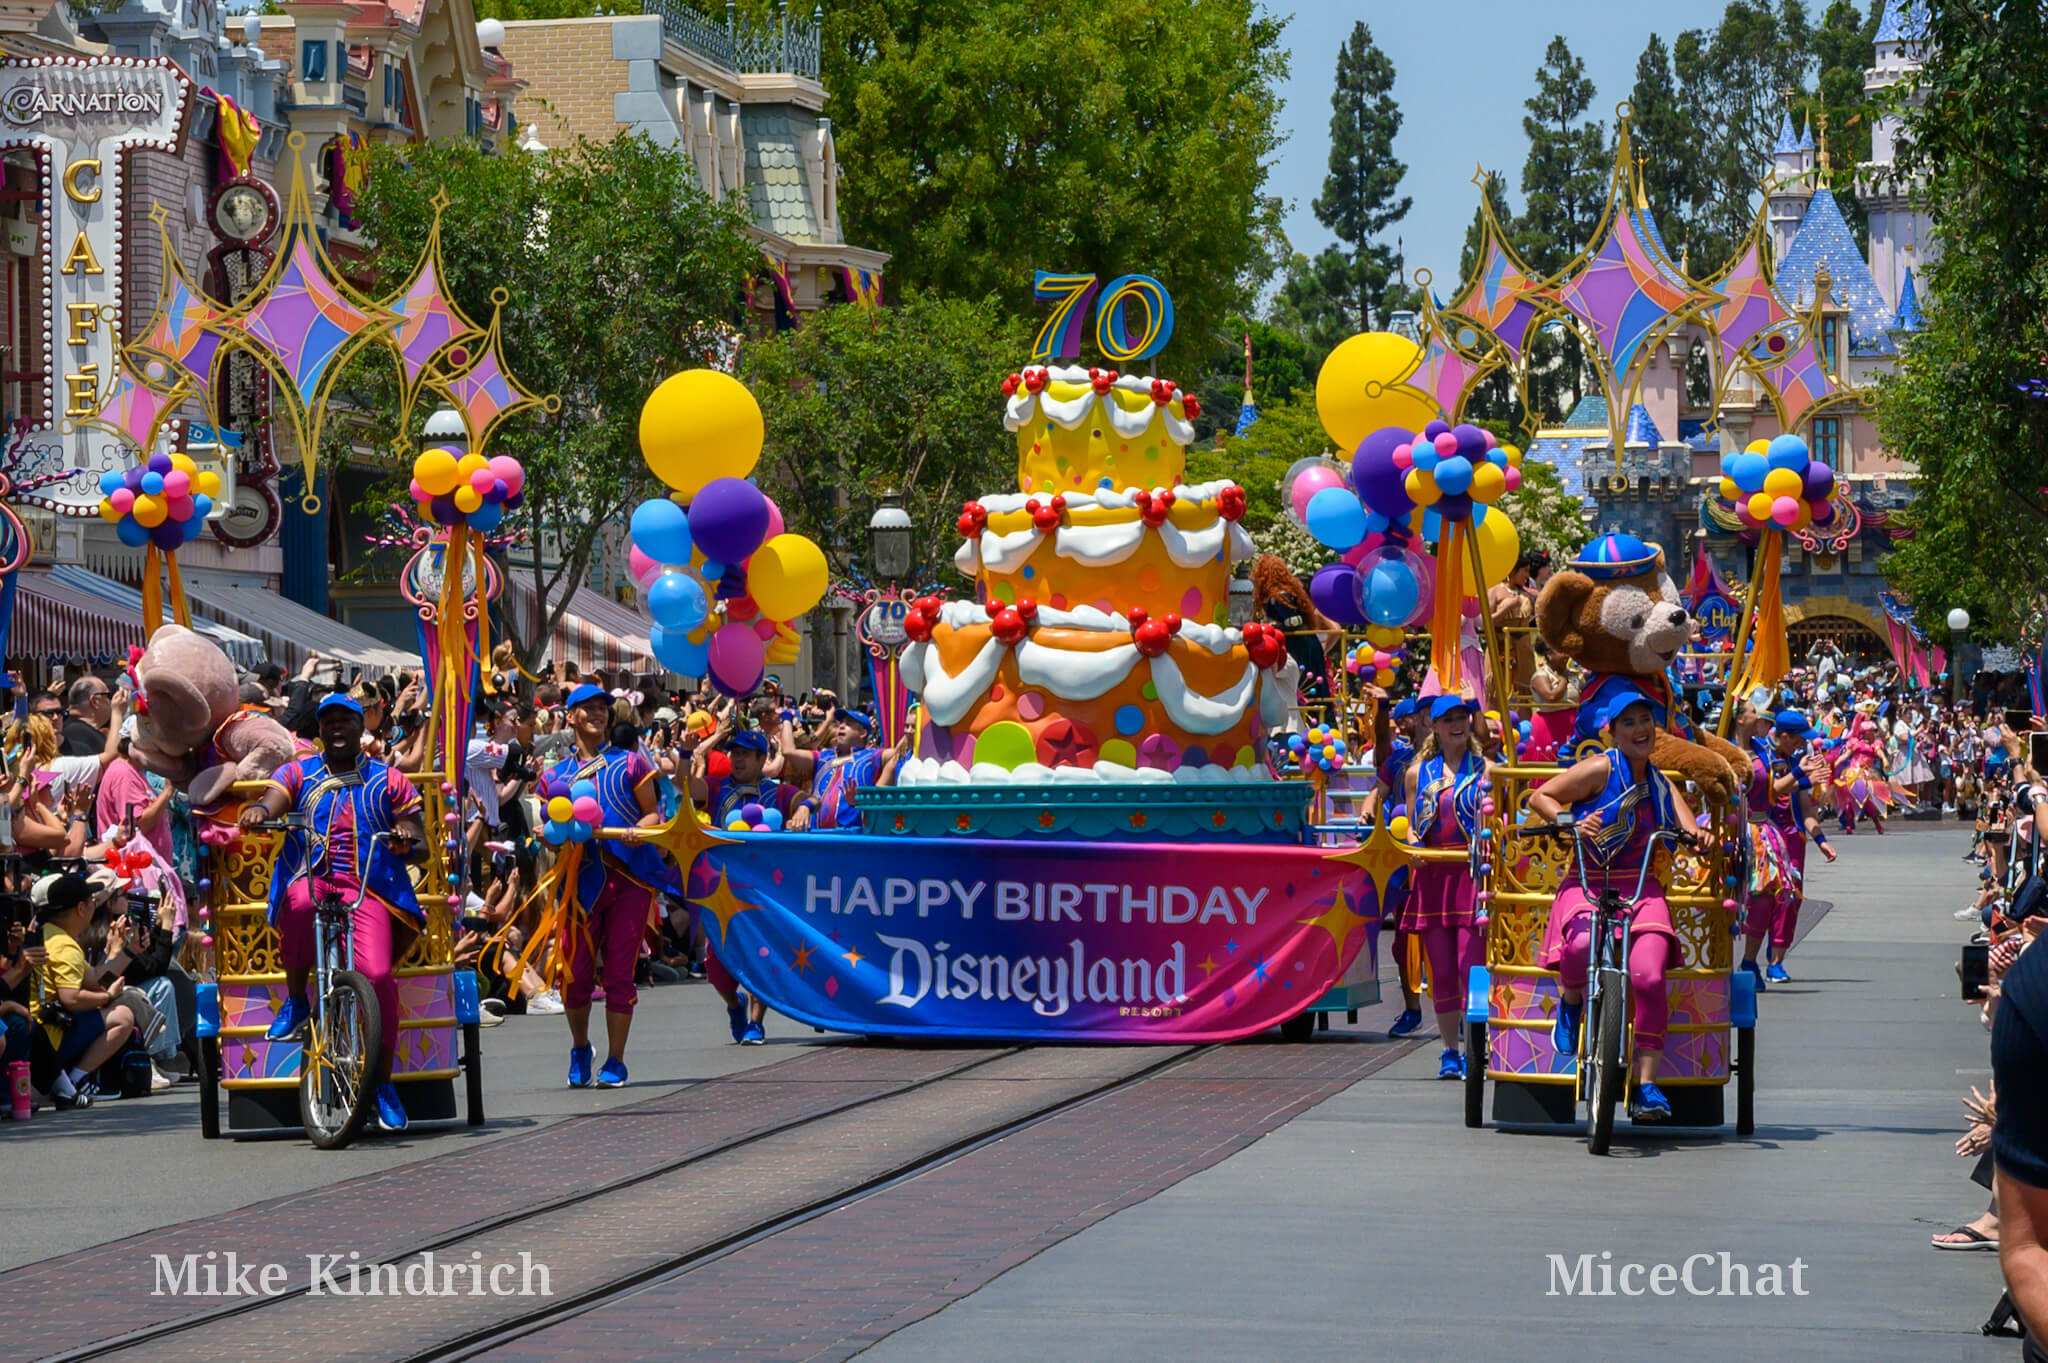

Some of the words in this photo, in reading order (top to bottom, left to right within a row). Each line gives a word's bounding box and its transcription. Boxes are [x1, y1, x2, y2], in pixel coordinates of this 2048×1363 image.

[2, 84, 164, 125] CARNATION
[61, 158, 104, 416] CAFÉ
[1031, 269, 1175, 361] 70
[877, 601, 906, 620] 70
[804, 875, 986, 919] HAPPY
[995, 881, 1270, 926] BIRTHDAY
[875, 931, 1190, 1017] Disneyland
[1119, 1006, 1183, 1017] RESORT
